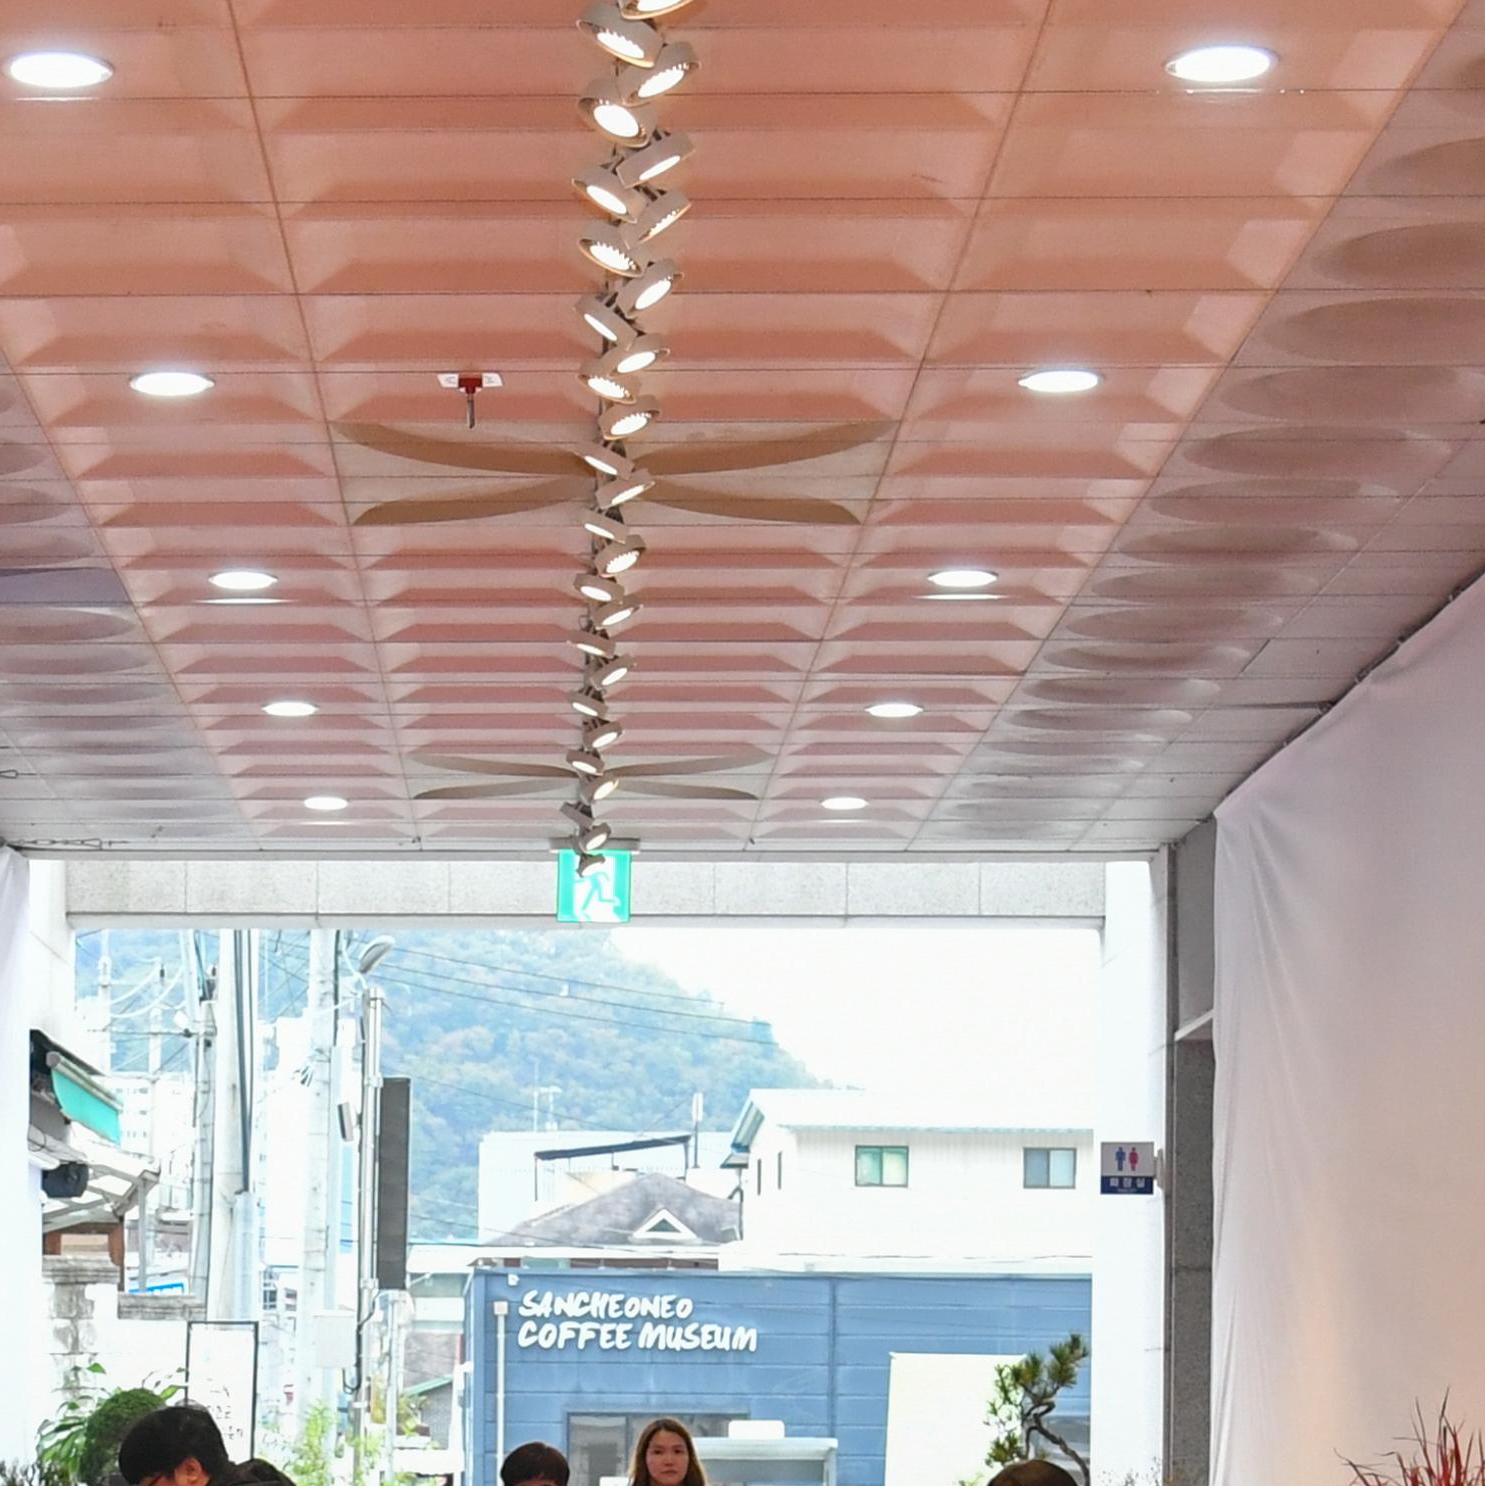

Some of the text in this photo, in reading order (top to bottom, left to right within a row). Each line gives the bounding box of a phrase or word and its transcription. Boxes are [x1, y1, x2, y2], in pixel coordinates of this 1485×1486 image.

[518, 1290, 693, 1319] SANCHEONEO
[517, 1320, 757, 1352] COFFEE MUSEUM
